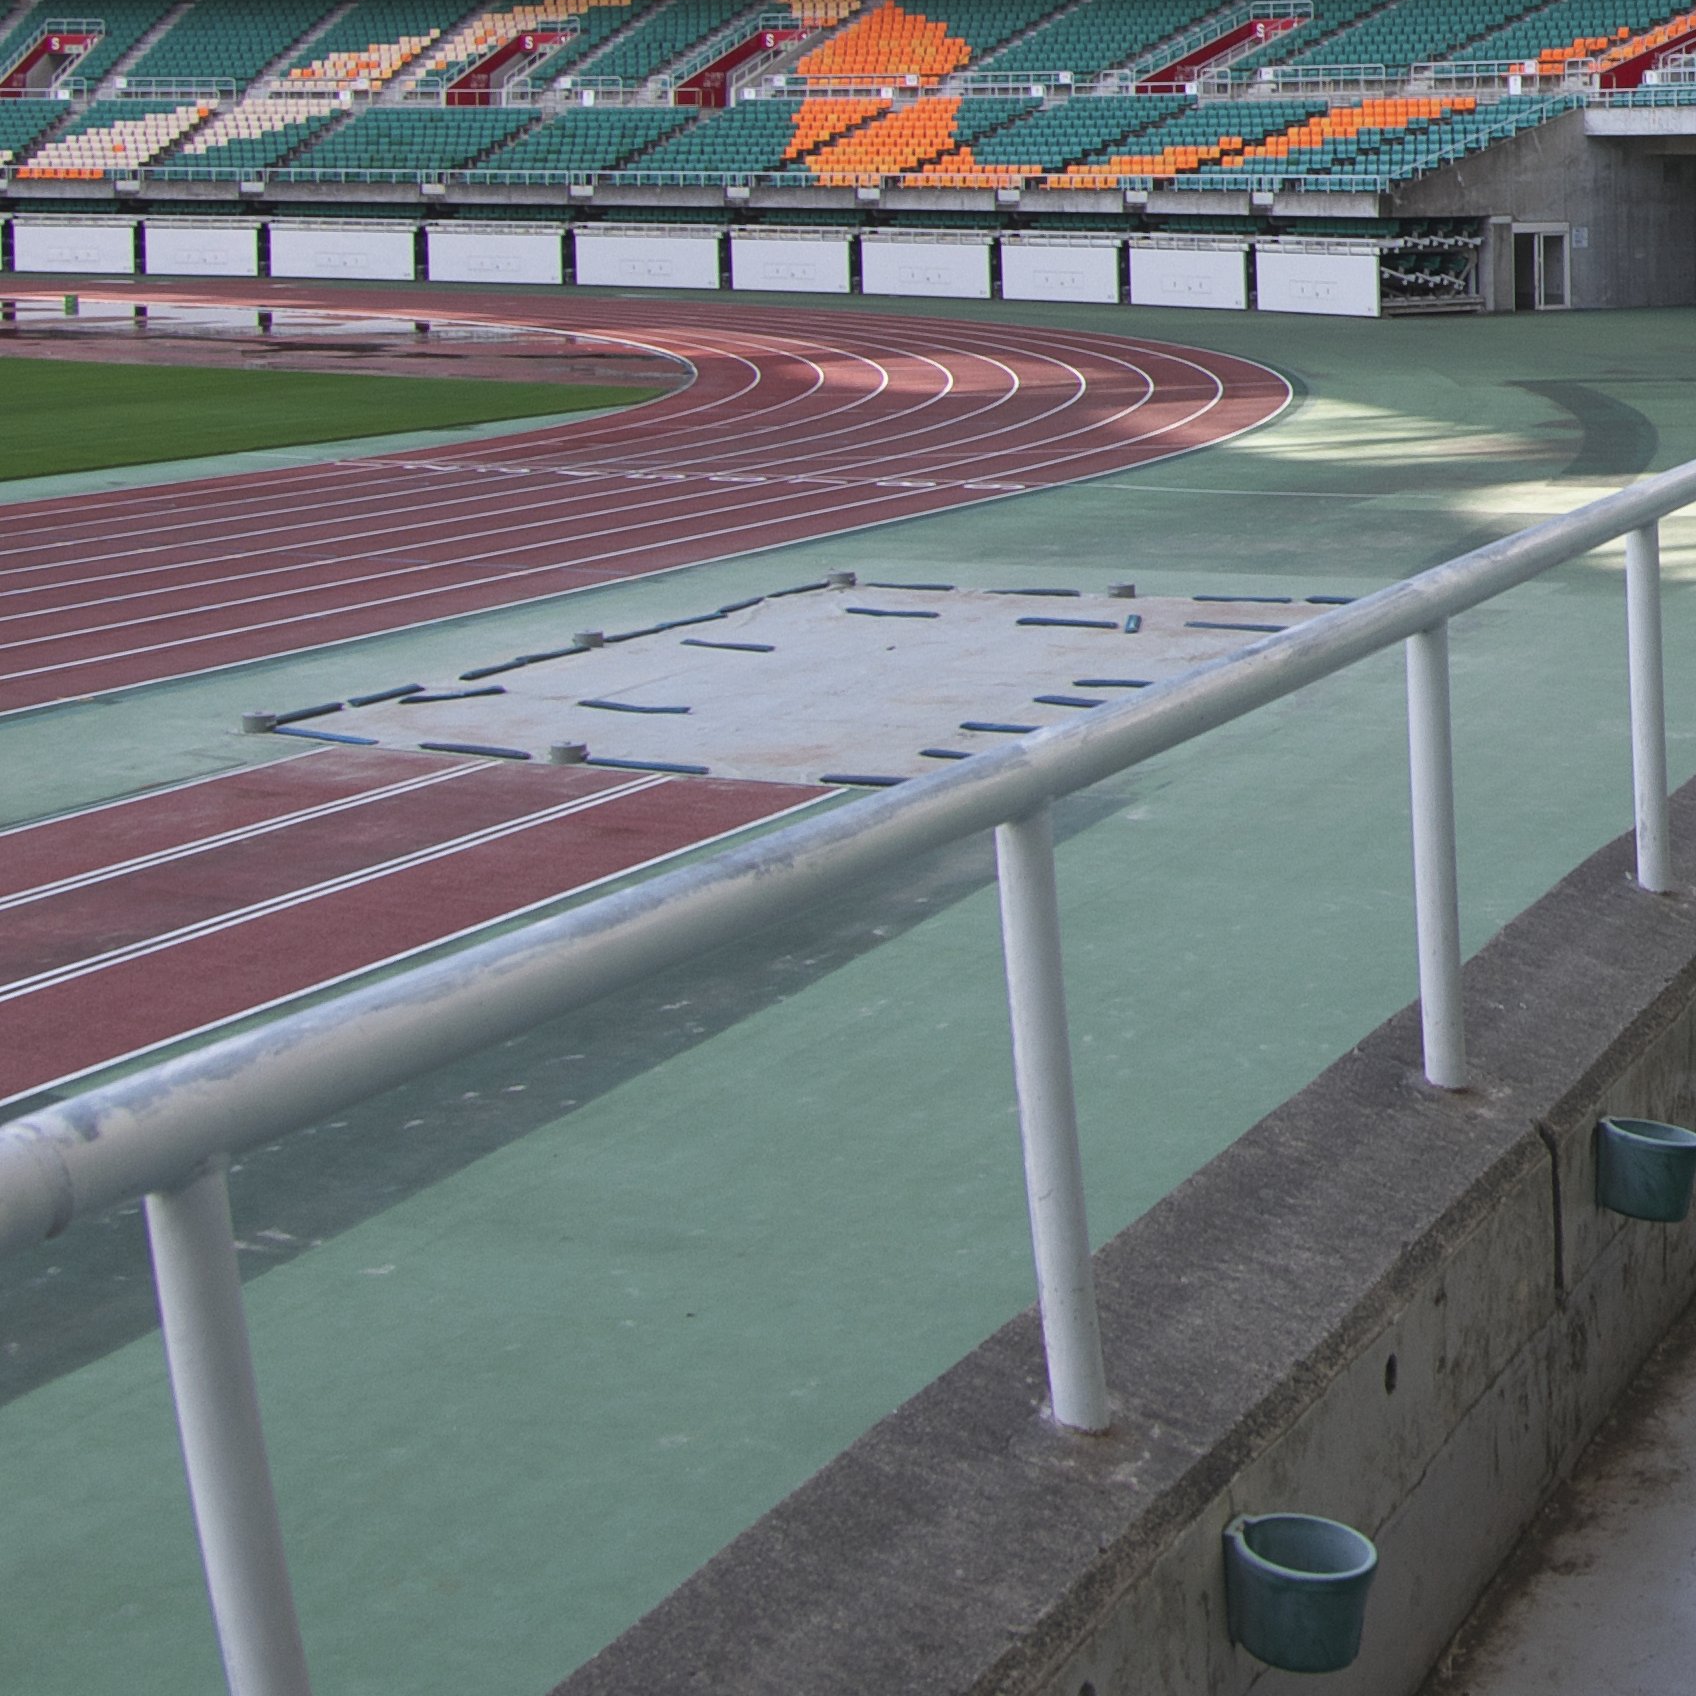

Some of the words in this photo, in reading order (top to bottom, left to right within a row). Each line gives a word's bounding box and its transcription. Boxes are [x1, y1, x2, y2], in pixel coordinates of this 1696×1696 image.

[1256, 23, 1265, 38] S
[51, 37, 60, 50] S
[525, 36, 534, 50] S
[766, 33, 775, 47] S
